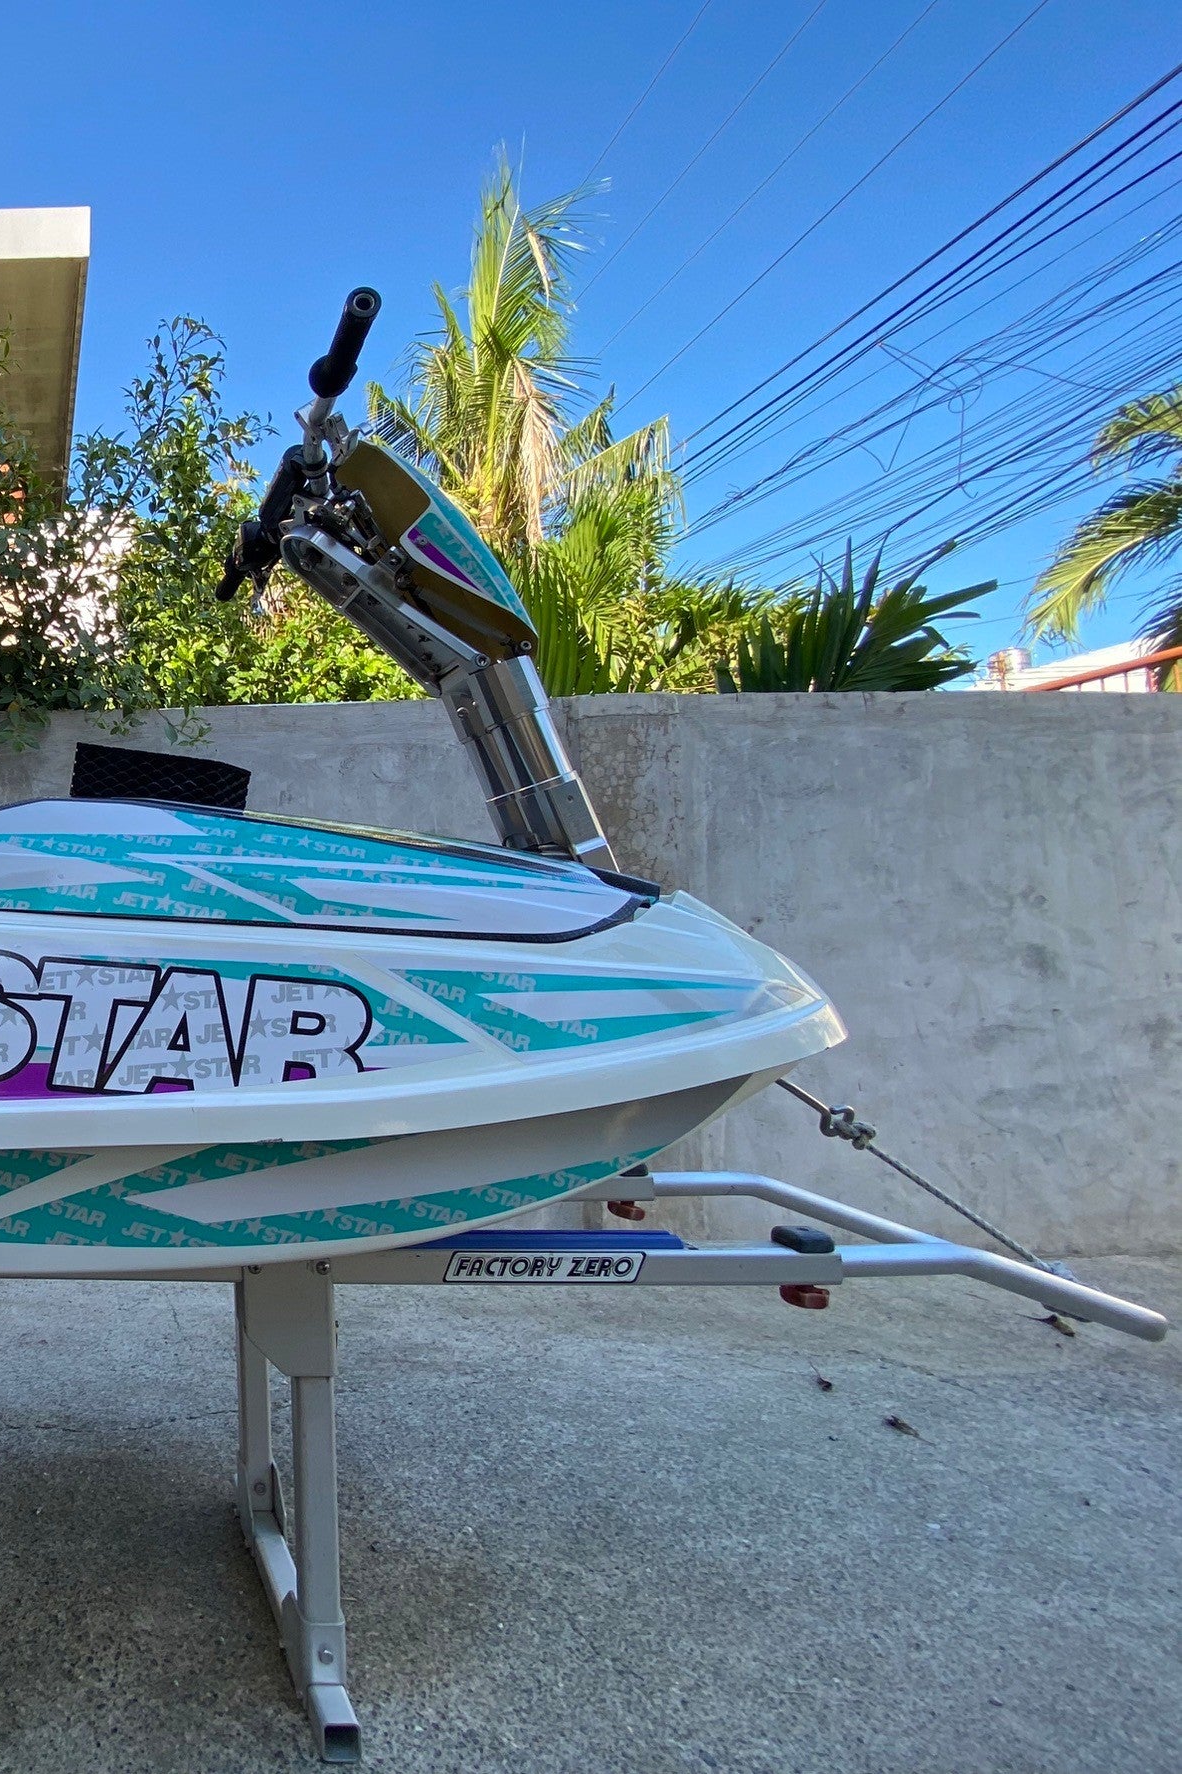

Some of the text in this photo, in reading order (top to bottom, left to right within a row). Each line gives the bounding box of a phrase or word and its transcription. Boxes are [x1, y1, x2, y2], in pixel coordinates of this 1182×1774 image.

[57, 841, 107, 857] STAR
[313, 841, 366, 859] STAR
[113, 891, 228, 919] JET STAR
[271, 984, 314, 1003] JET
[119, 1062, 167, 1087] JET
[48, 1200, 106, 1228] STAR
[413, 1202, 468, 1223] STAR
[121, 1221, 166, 1243] JET
[337, 1215, 395, 1236] STAR
[453, 1256, 634, 1277] FACTORY ZERO
